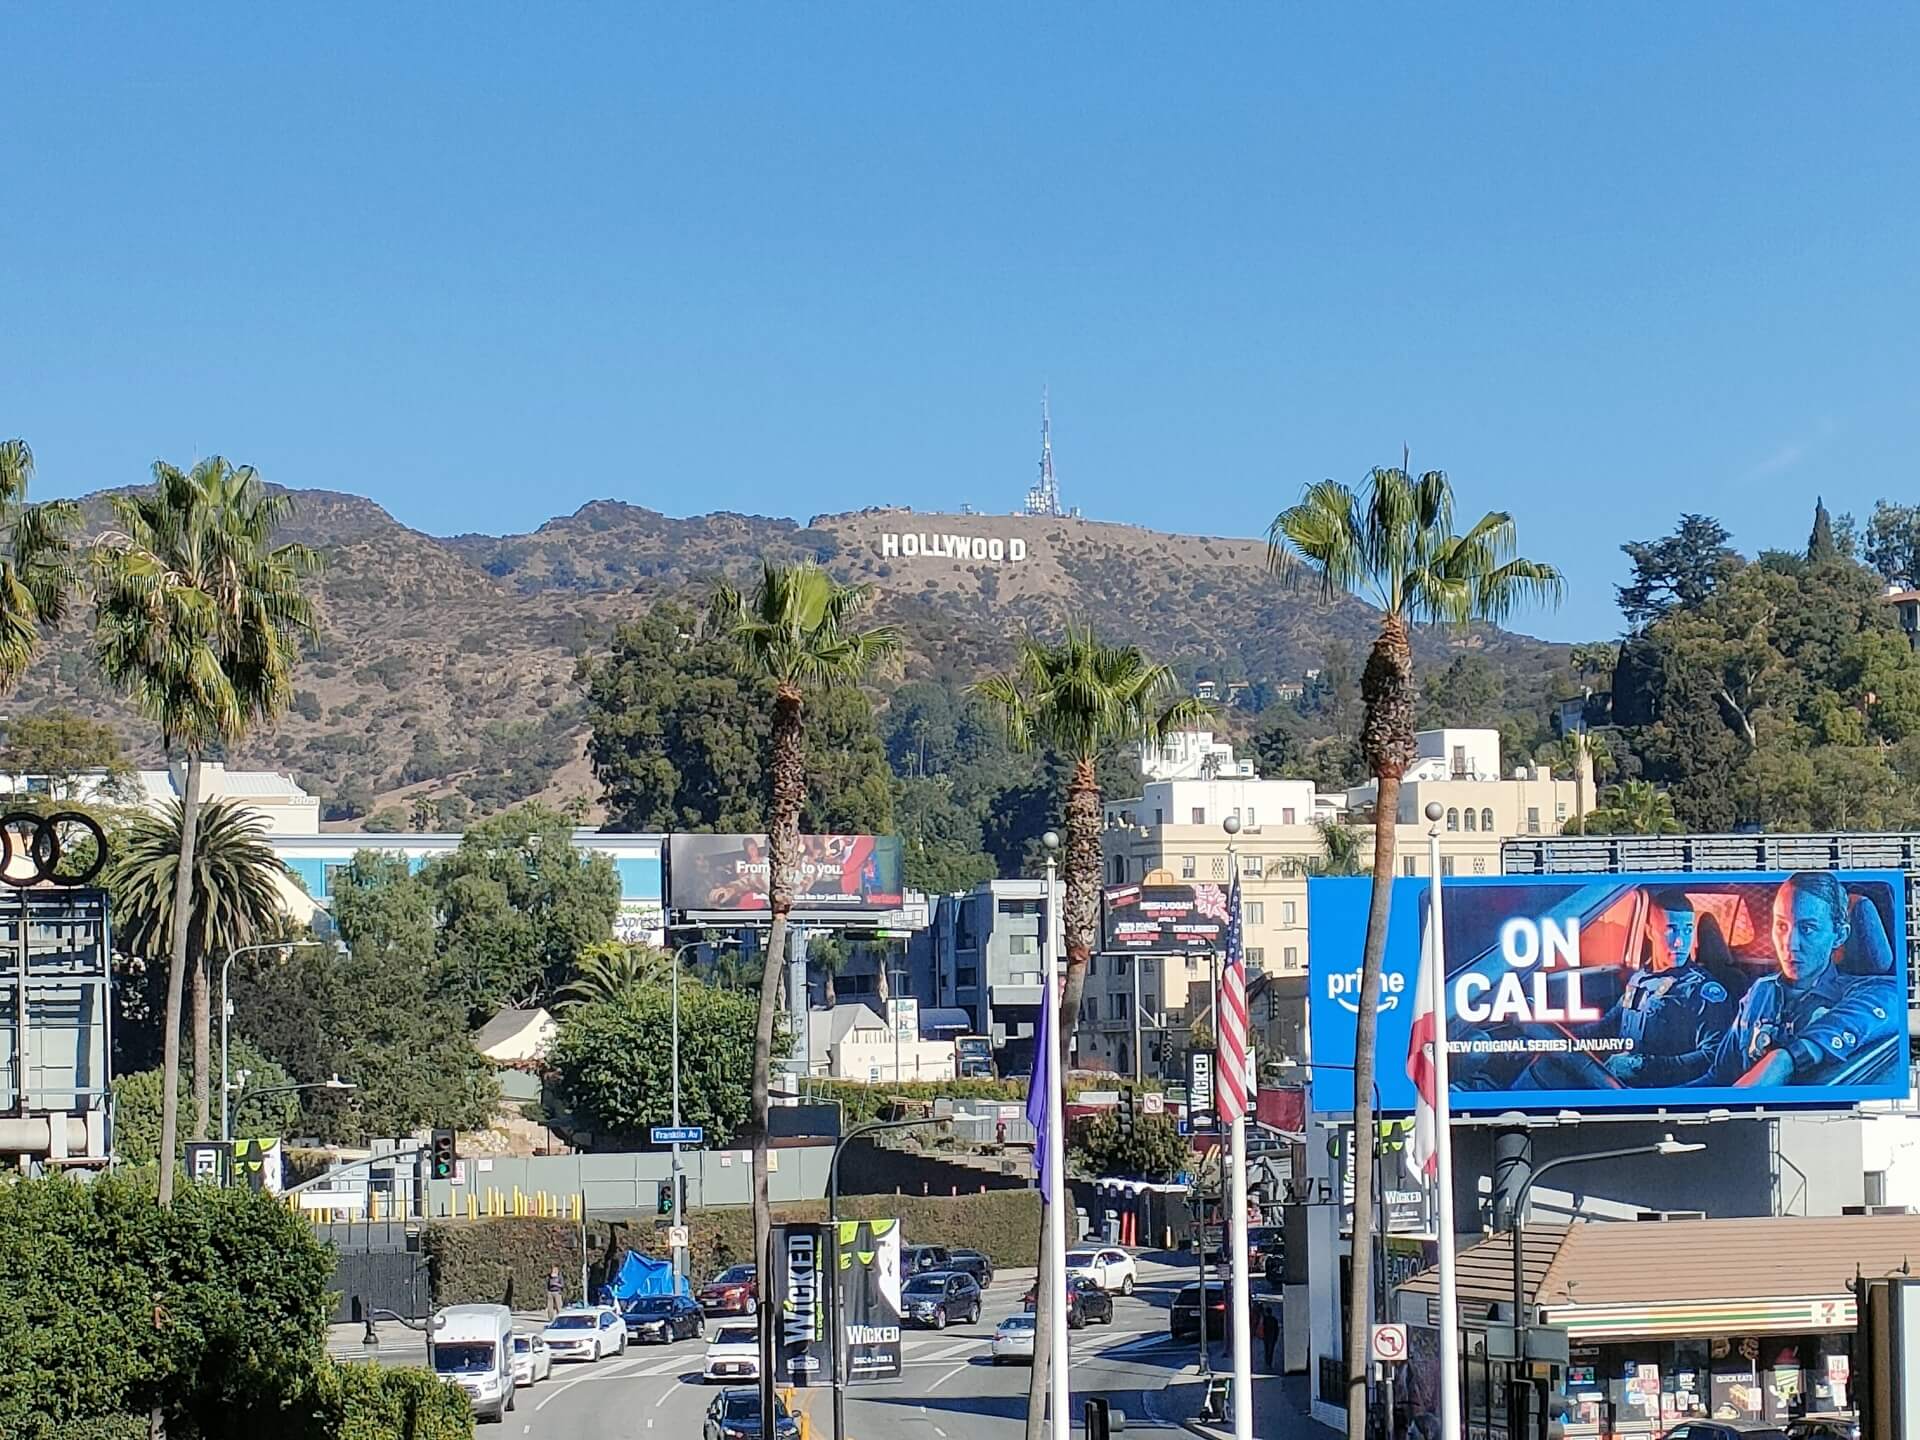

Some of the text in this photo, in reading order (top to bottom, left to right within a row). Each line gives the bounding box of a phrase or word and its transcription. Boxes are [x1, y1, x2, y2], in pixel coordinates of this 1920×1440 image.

[882, 533, 1026, 561] HOLLYWOOD
[736, 861, 844, 878] From to you.
[1502, 916, 1581, 968] ON
[1455, 972, 1601, 1022] CALL
[1446, 1041, 1472, 1053] NEW
[1473, 1040, 1527, 1052] ORIGINAL
[1528, 1039, 1567, 1052] SERIES
[1573, 1038, 1624, 1051] JANUARY
[1625, 1038, 1634, 1050] 9
[655, 1130, 698, 1139] Franklin Av
